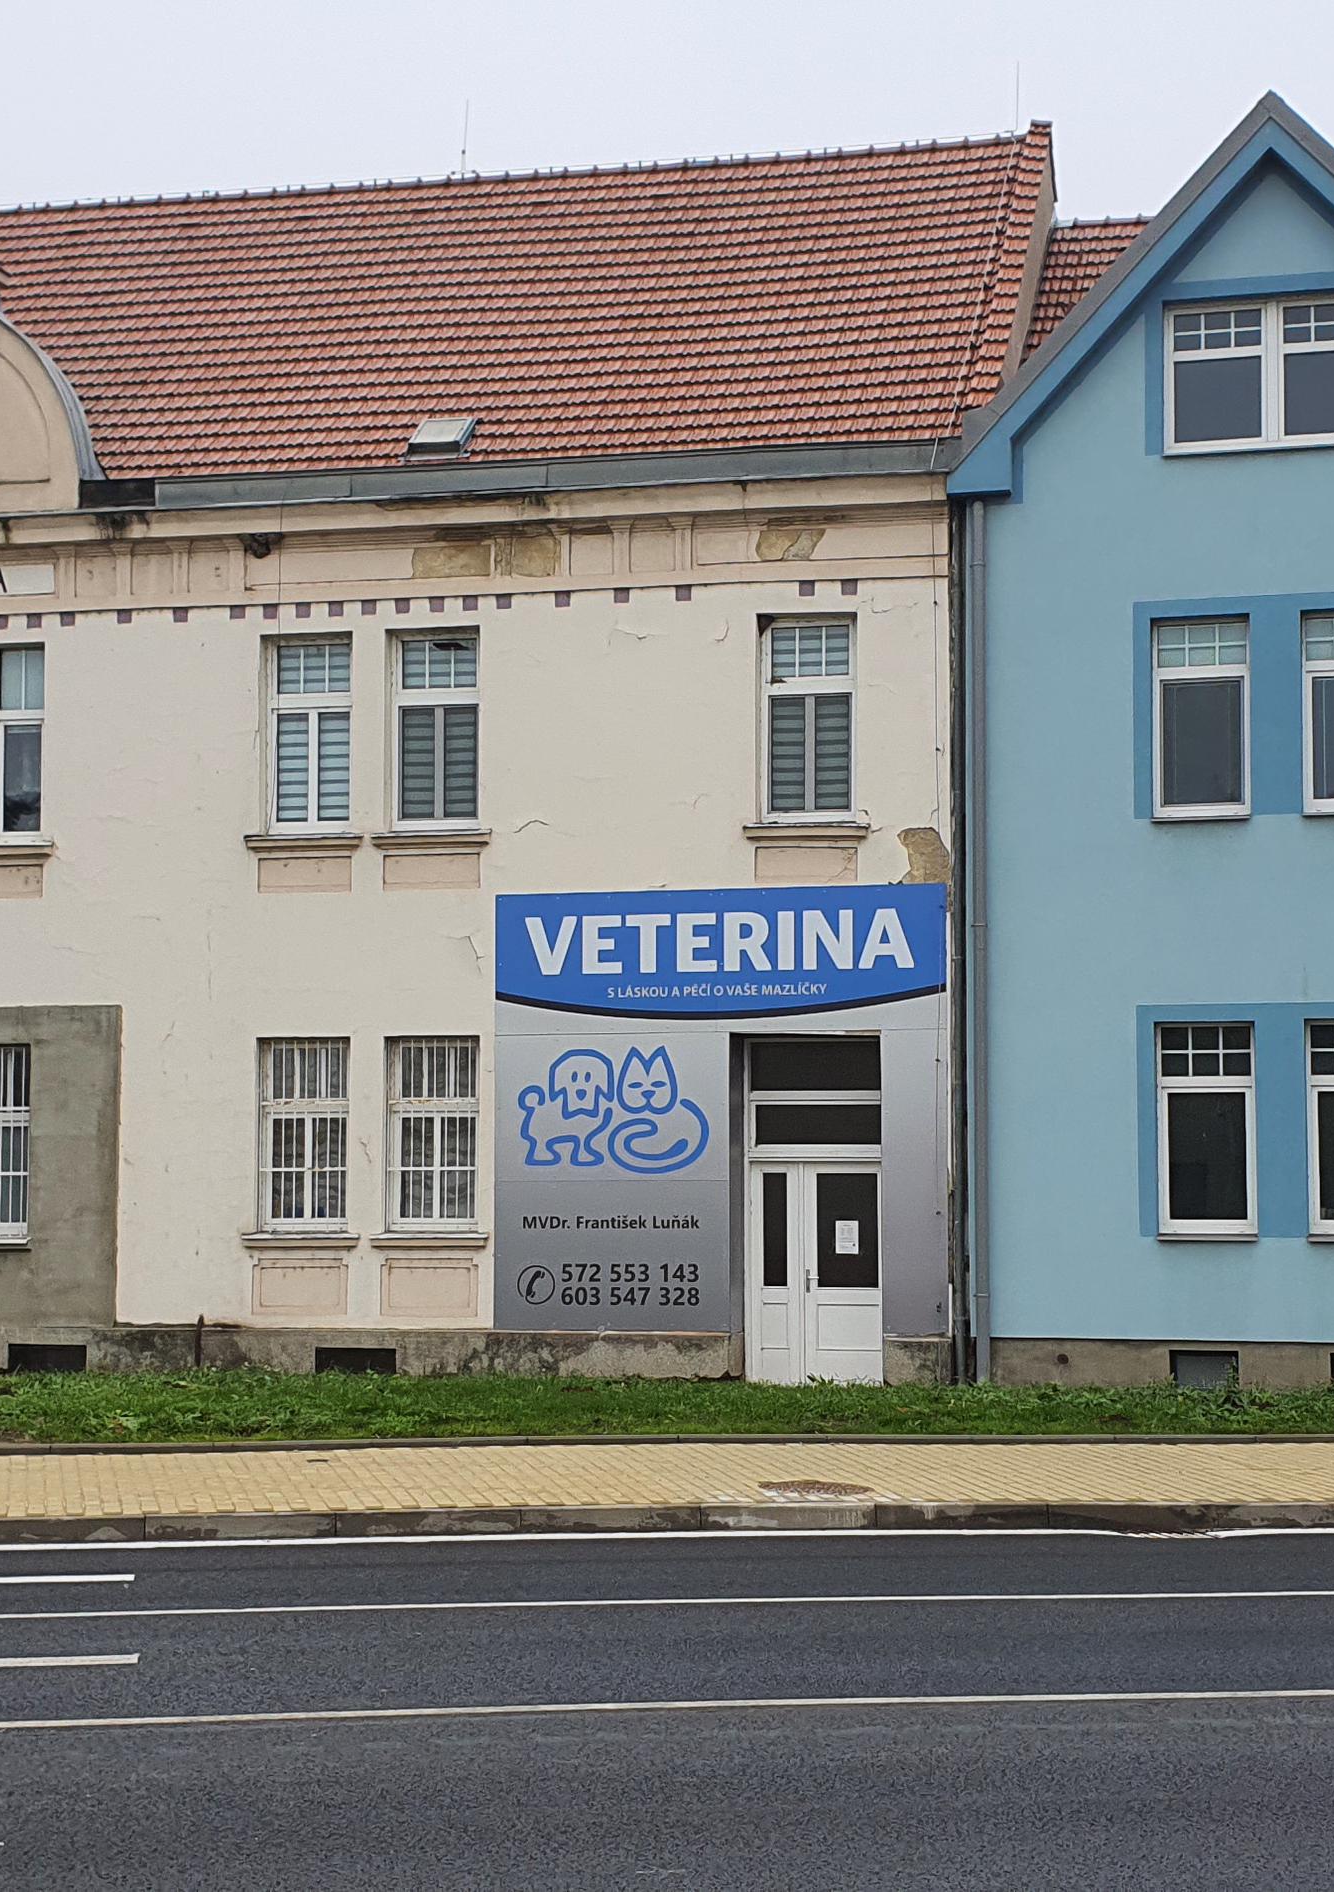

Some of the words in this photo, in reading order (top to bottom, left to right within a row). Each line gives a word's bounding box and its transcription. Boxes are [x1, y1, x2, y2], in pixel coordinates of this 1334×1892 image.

[524, 907, 915, 976] VETERINA
[607, 986, 615, 998] S
[617, 984, 668, 998] LÁSKOU
[671, 986, 681, 997] A
[713, 984, 724, 996] O
[726, 982, 759, 996] VAŠE
[761, 981, 827, 996] MAZLÍČKY
[522, 1215, 570, 1229] MVDr.
[576, 1214, 647, 1229] František
[652, 1214, 699, 1229] Luňák
[561, 1263, 601, 1283] 572
[609, 1263, 650, 1283] 553
[659, 1263, 699, 1283] 143
[561, 1286, 601, 1306] 603
[609, 1286, 651, 1306] 547
[658, 1286, 700, 1306] 328
